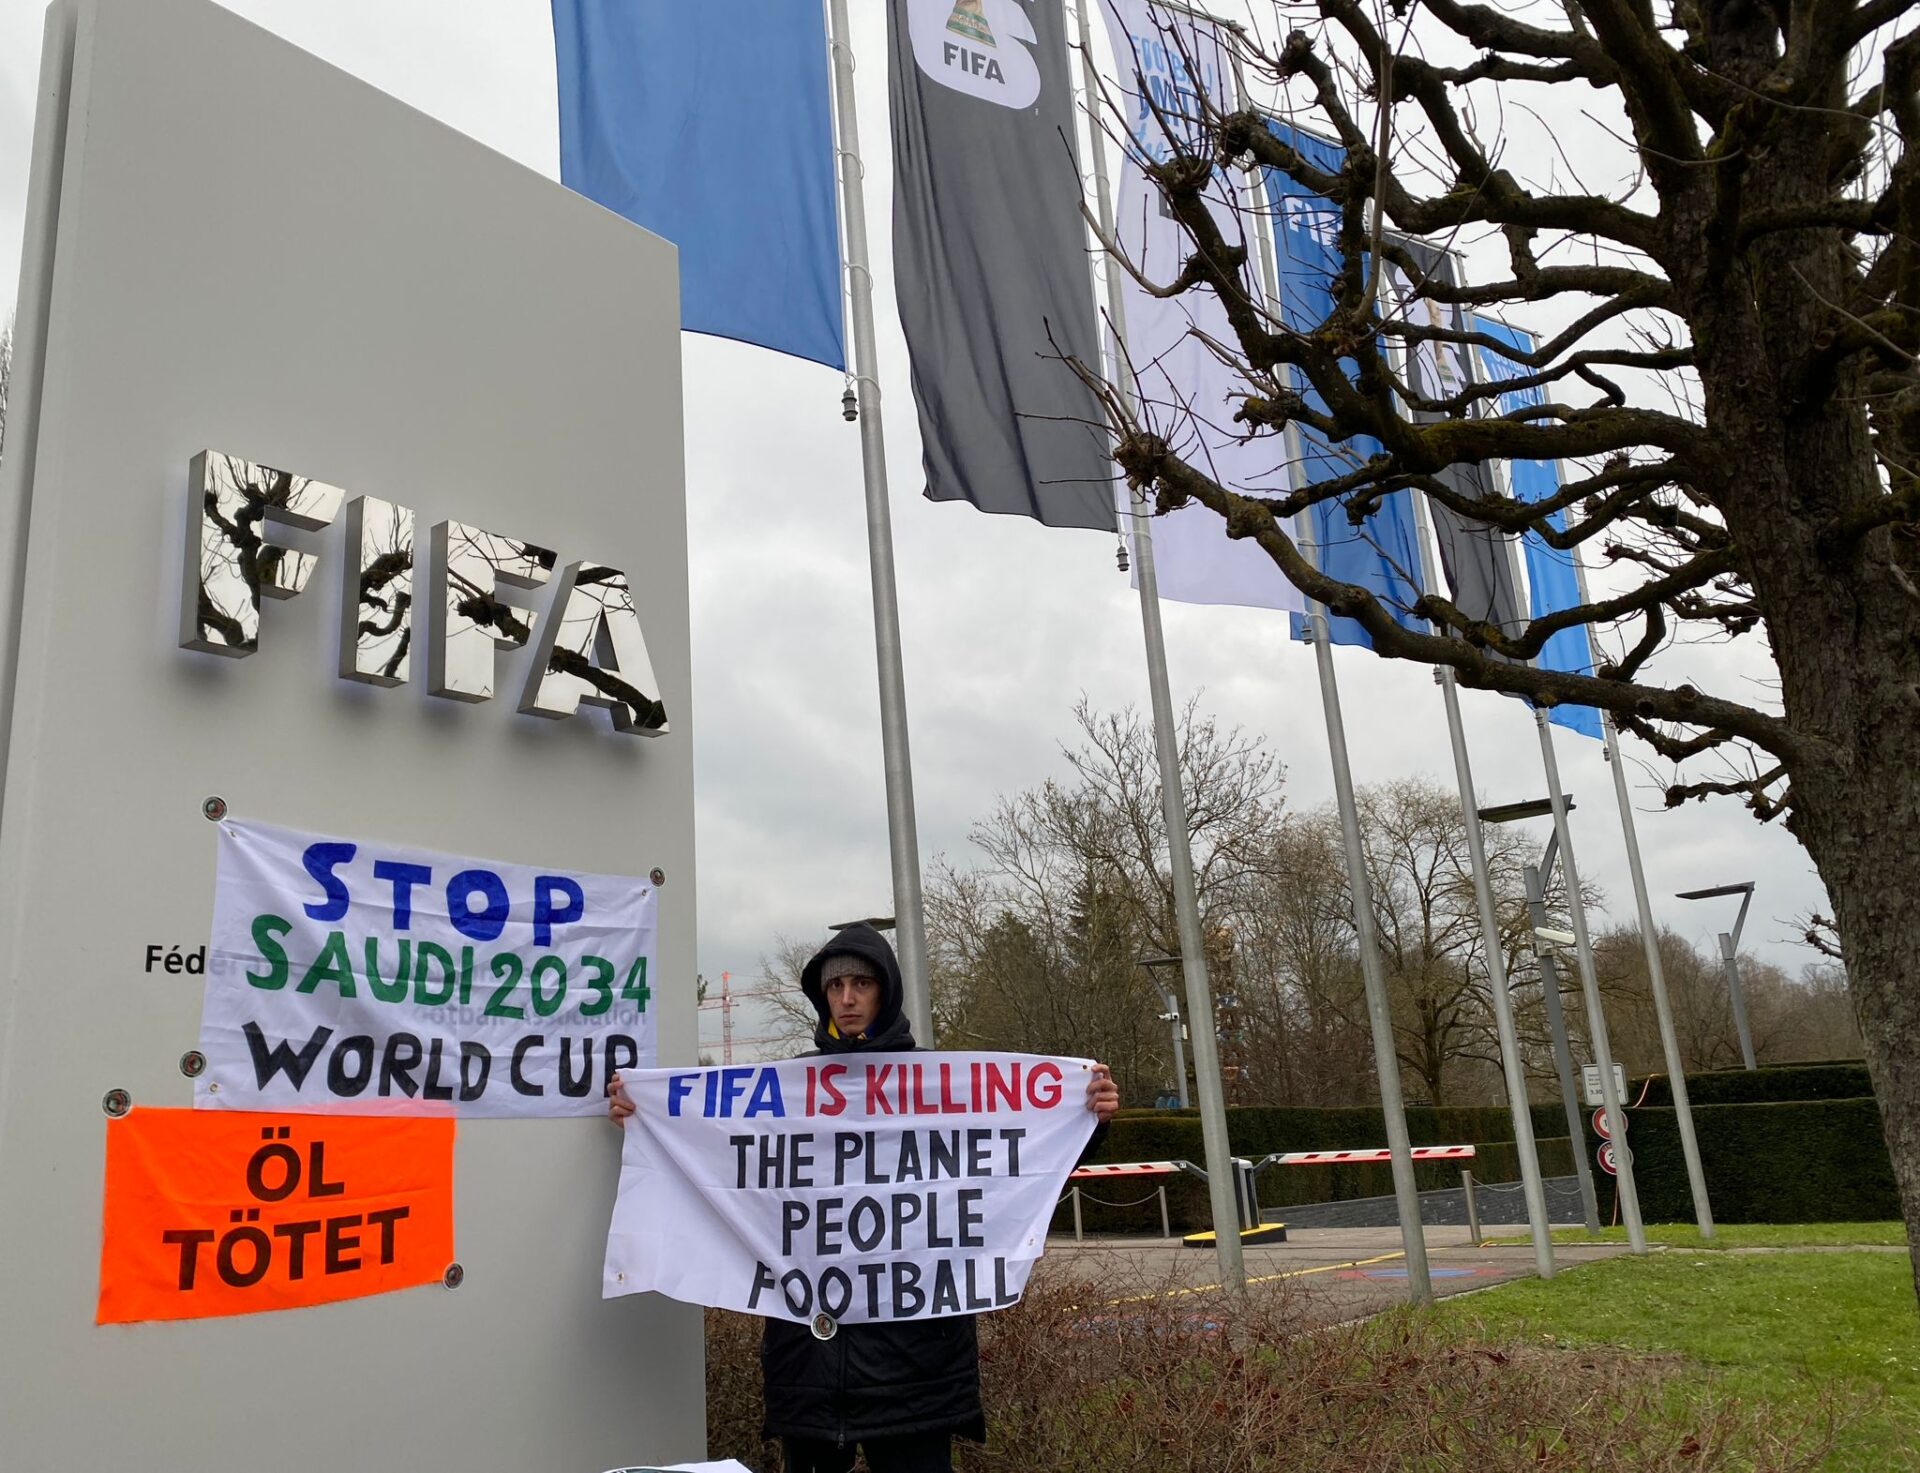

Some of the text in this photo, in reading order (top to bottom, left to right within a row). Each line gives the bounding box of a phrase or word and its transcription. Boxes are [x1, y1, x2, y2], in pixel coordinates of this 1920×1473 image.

[943, 40, 1006, 85] FIFA
[1283, 192, 1344, 248] FIF
[179, 449, 670, 738] FIFA
[302, 842, 585, 947] STOP
[245, 913, 651, 1019] SAUDI 2034
[241, 1020, 638, 1101] WORLD CUP
[668, 1062, 1063, 1119] FIFA IS KILLING
[246, 1126, 345, 1202] ÖL
[729, 1128, 1027, 1190] THE PLANET
[162, 1205, 410, 1291] TÖTET
[781, 1188, 985, 1257] PEOPLE
[748, 1256, 1020, 1319] FOOTBALL
